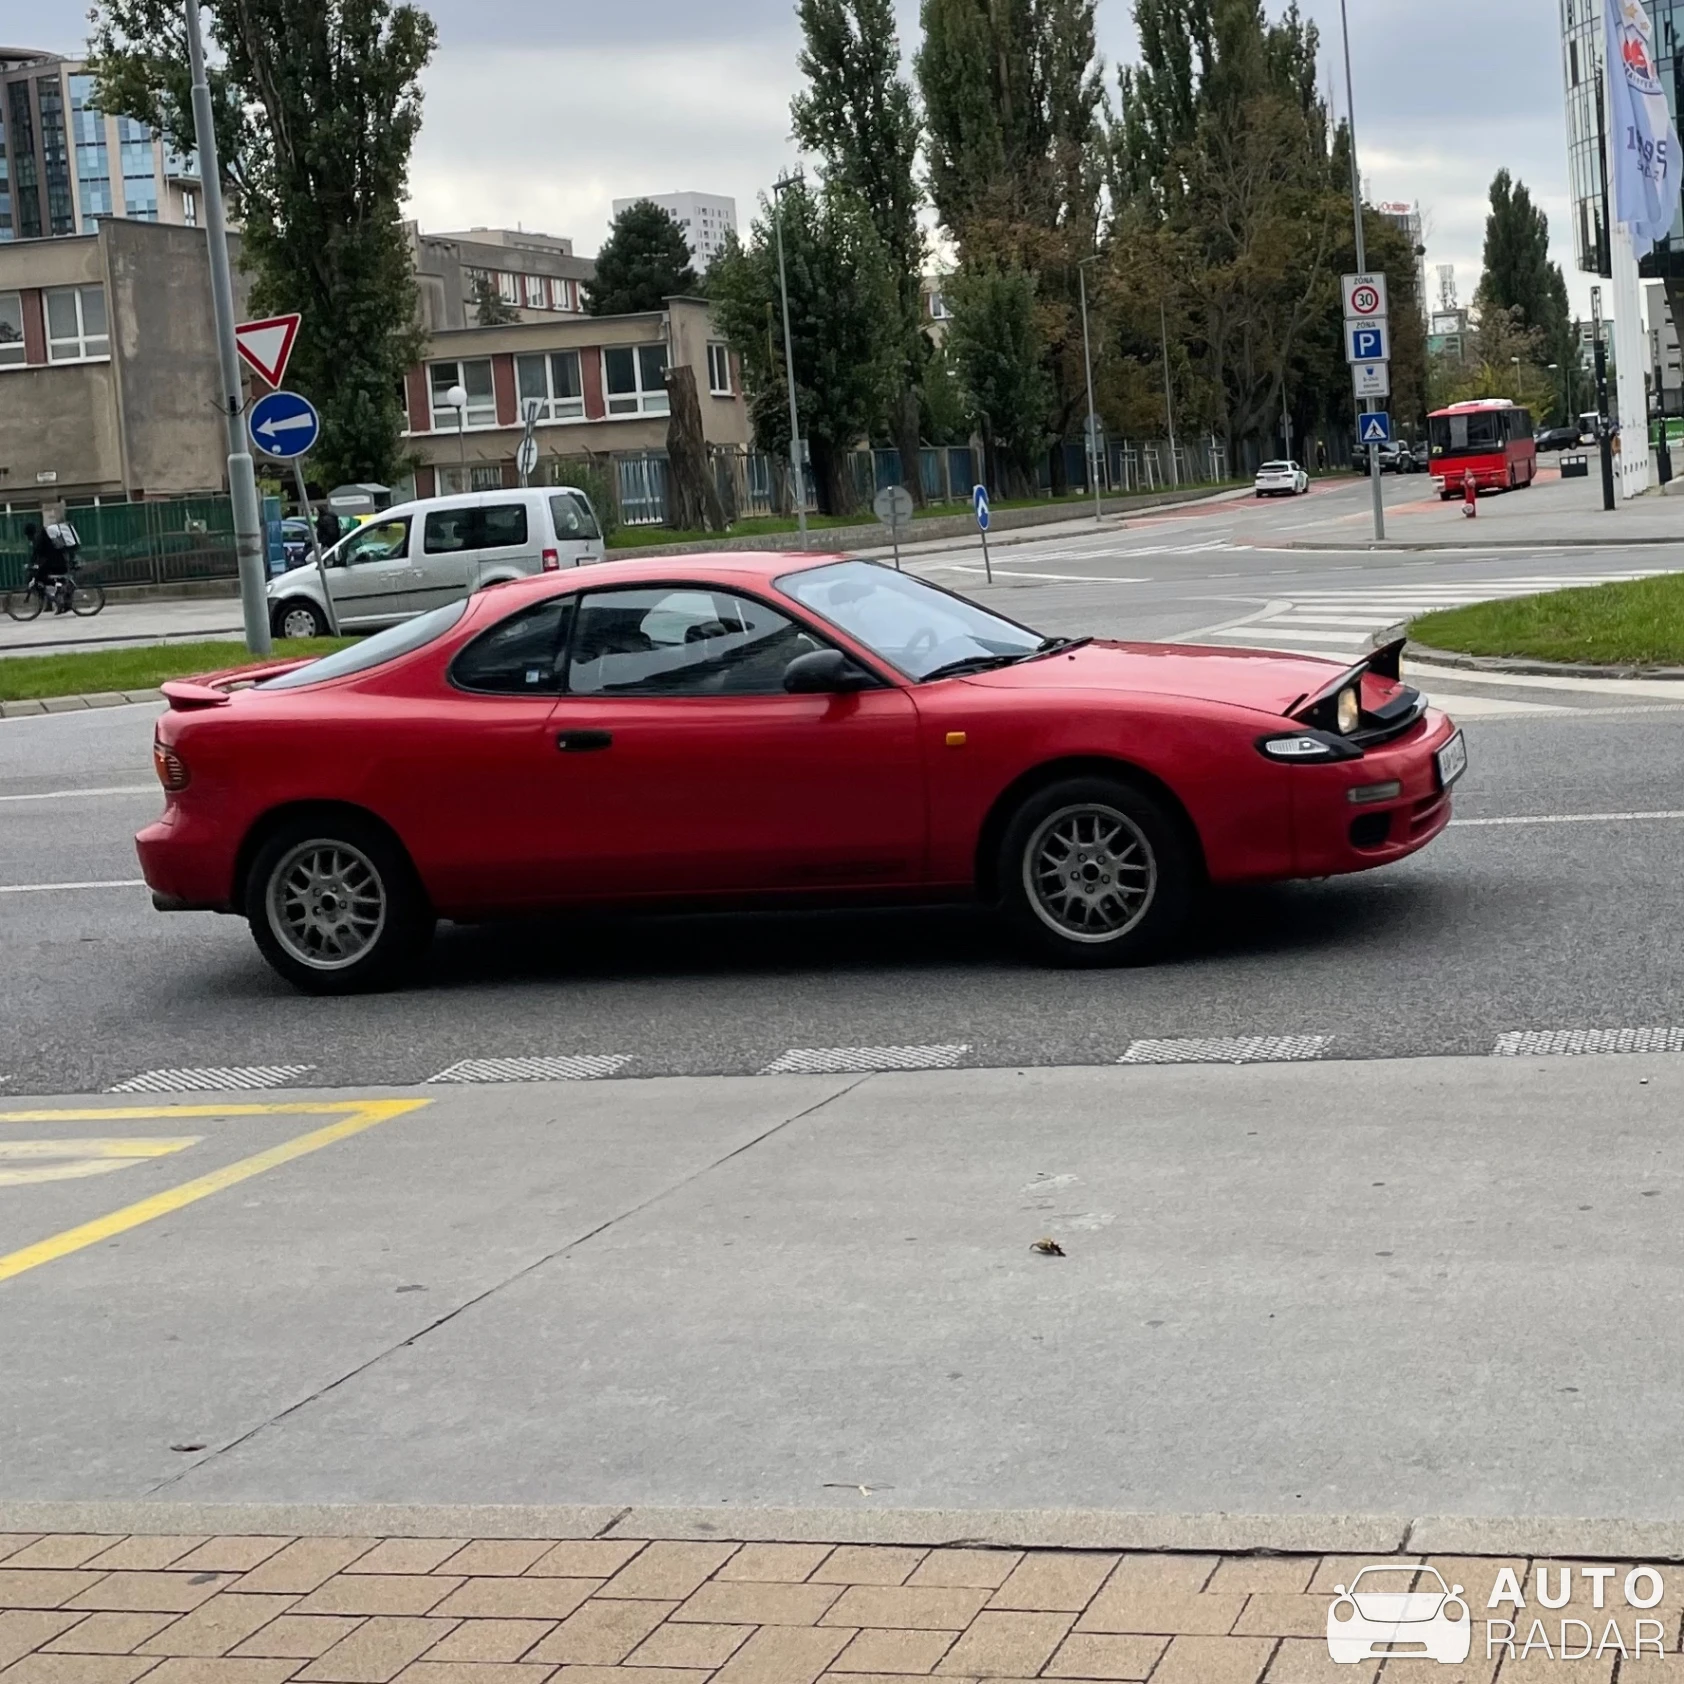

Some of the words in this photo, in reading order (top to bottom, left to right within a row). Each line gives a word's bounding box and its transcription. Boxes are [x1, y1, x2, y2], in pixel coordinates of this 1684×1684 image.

[1354, 276, 1374, 285] ZÓNA
[1357, 293, 1374, 307] 30
[1356, 321, 1376, 329] ZÓNA
[1359, 333, 1375, 356] P
